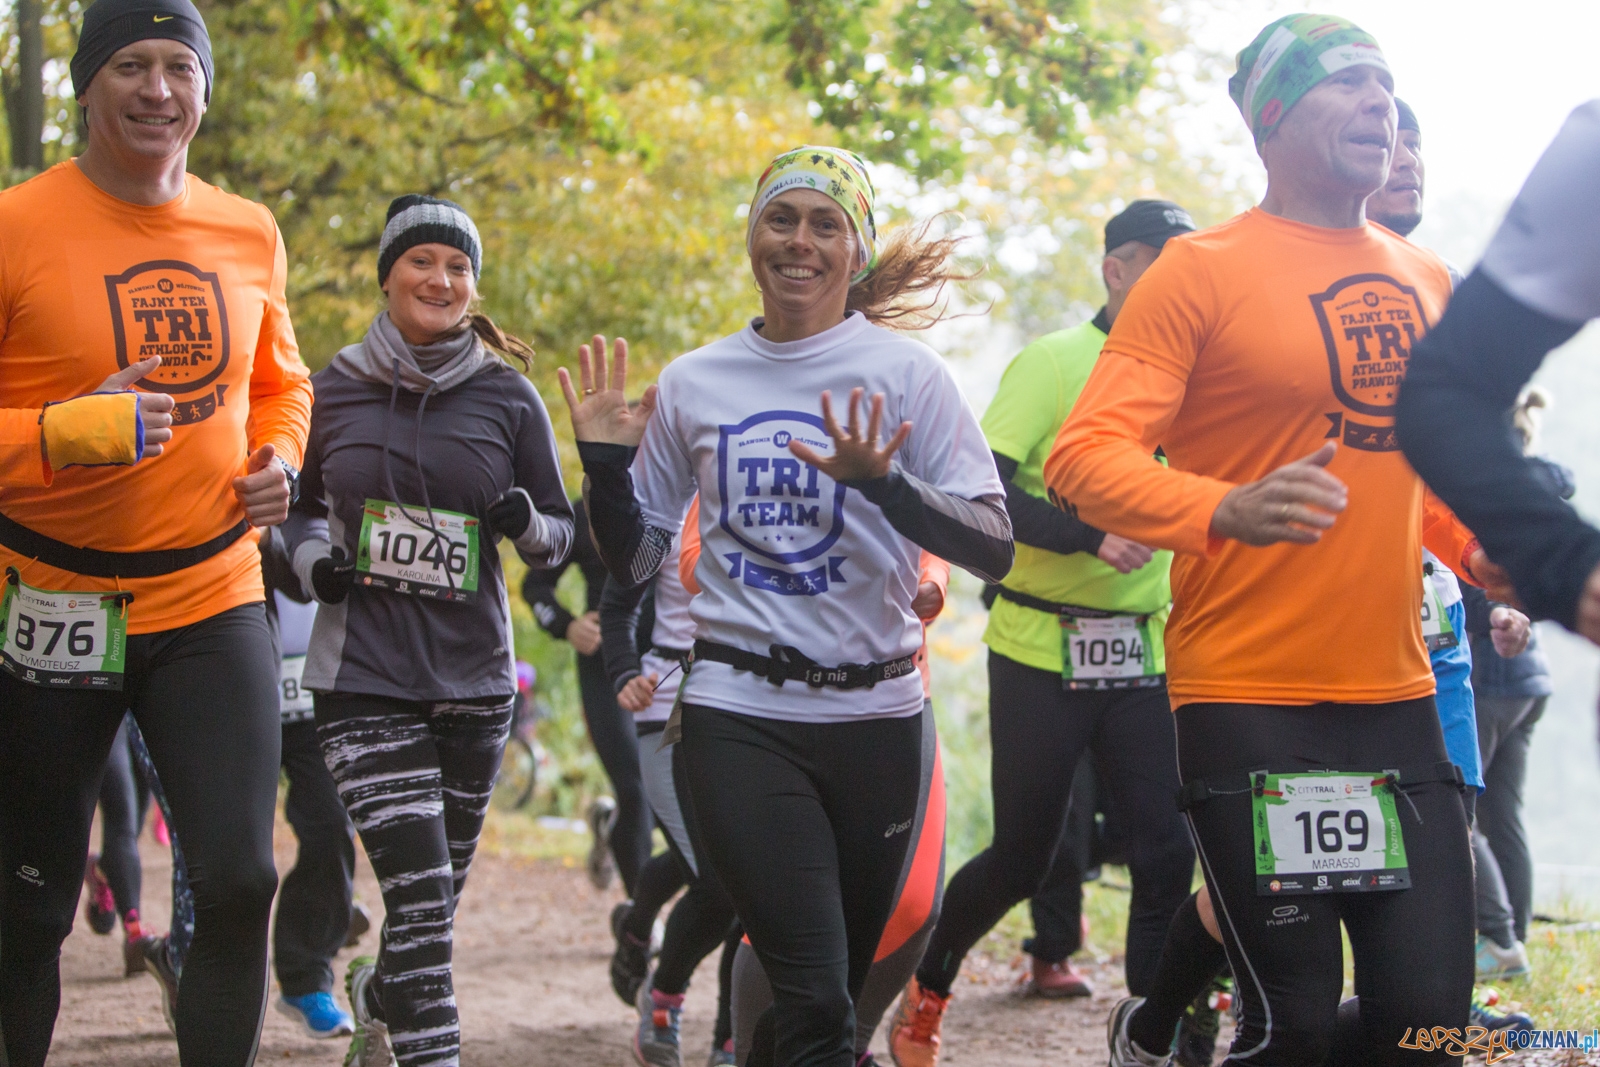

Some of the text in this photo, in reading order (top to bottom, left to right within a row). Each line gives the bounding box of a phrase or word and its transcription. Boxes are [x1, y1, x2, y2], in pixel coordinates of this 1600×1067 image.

[131, 296, 206, 308] FAJNY TEN
[134, 308, 212, 342] TRI
[1340, 309, 1412, 326] FAJNY TEN
[139, 344, 189, 355] ATHLON
[1352, 361, 1403, 376] ATHLON
[738, 457, 820, 499] TRI
[738, 502, 820, 527] TEAM
[378, 530, 467, 575] 1046
[397, 568, 441, 583] KAROLINA
[15, 612, 95, 657] 876
[111, 628, 121, 661] Poznań
[20, 653, 80, 670] TYMOTEUSZ
[1075, 638, 1143, 666] 1094
[884, 658, 913, 679] gdynia
[1295, 809, 1369, 854] 169
[1387, 818, 1400, 856] Poznań
[1312, 858, 1361, 870] MARASSO
